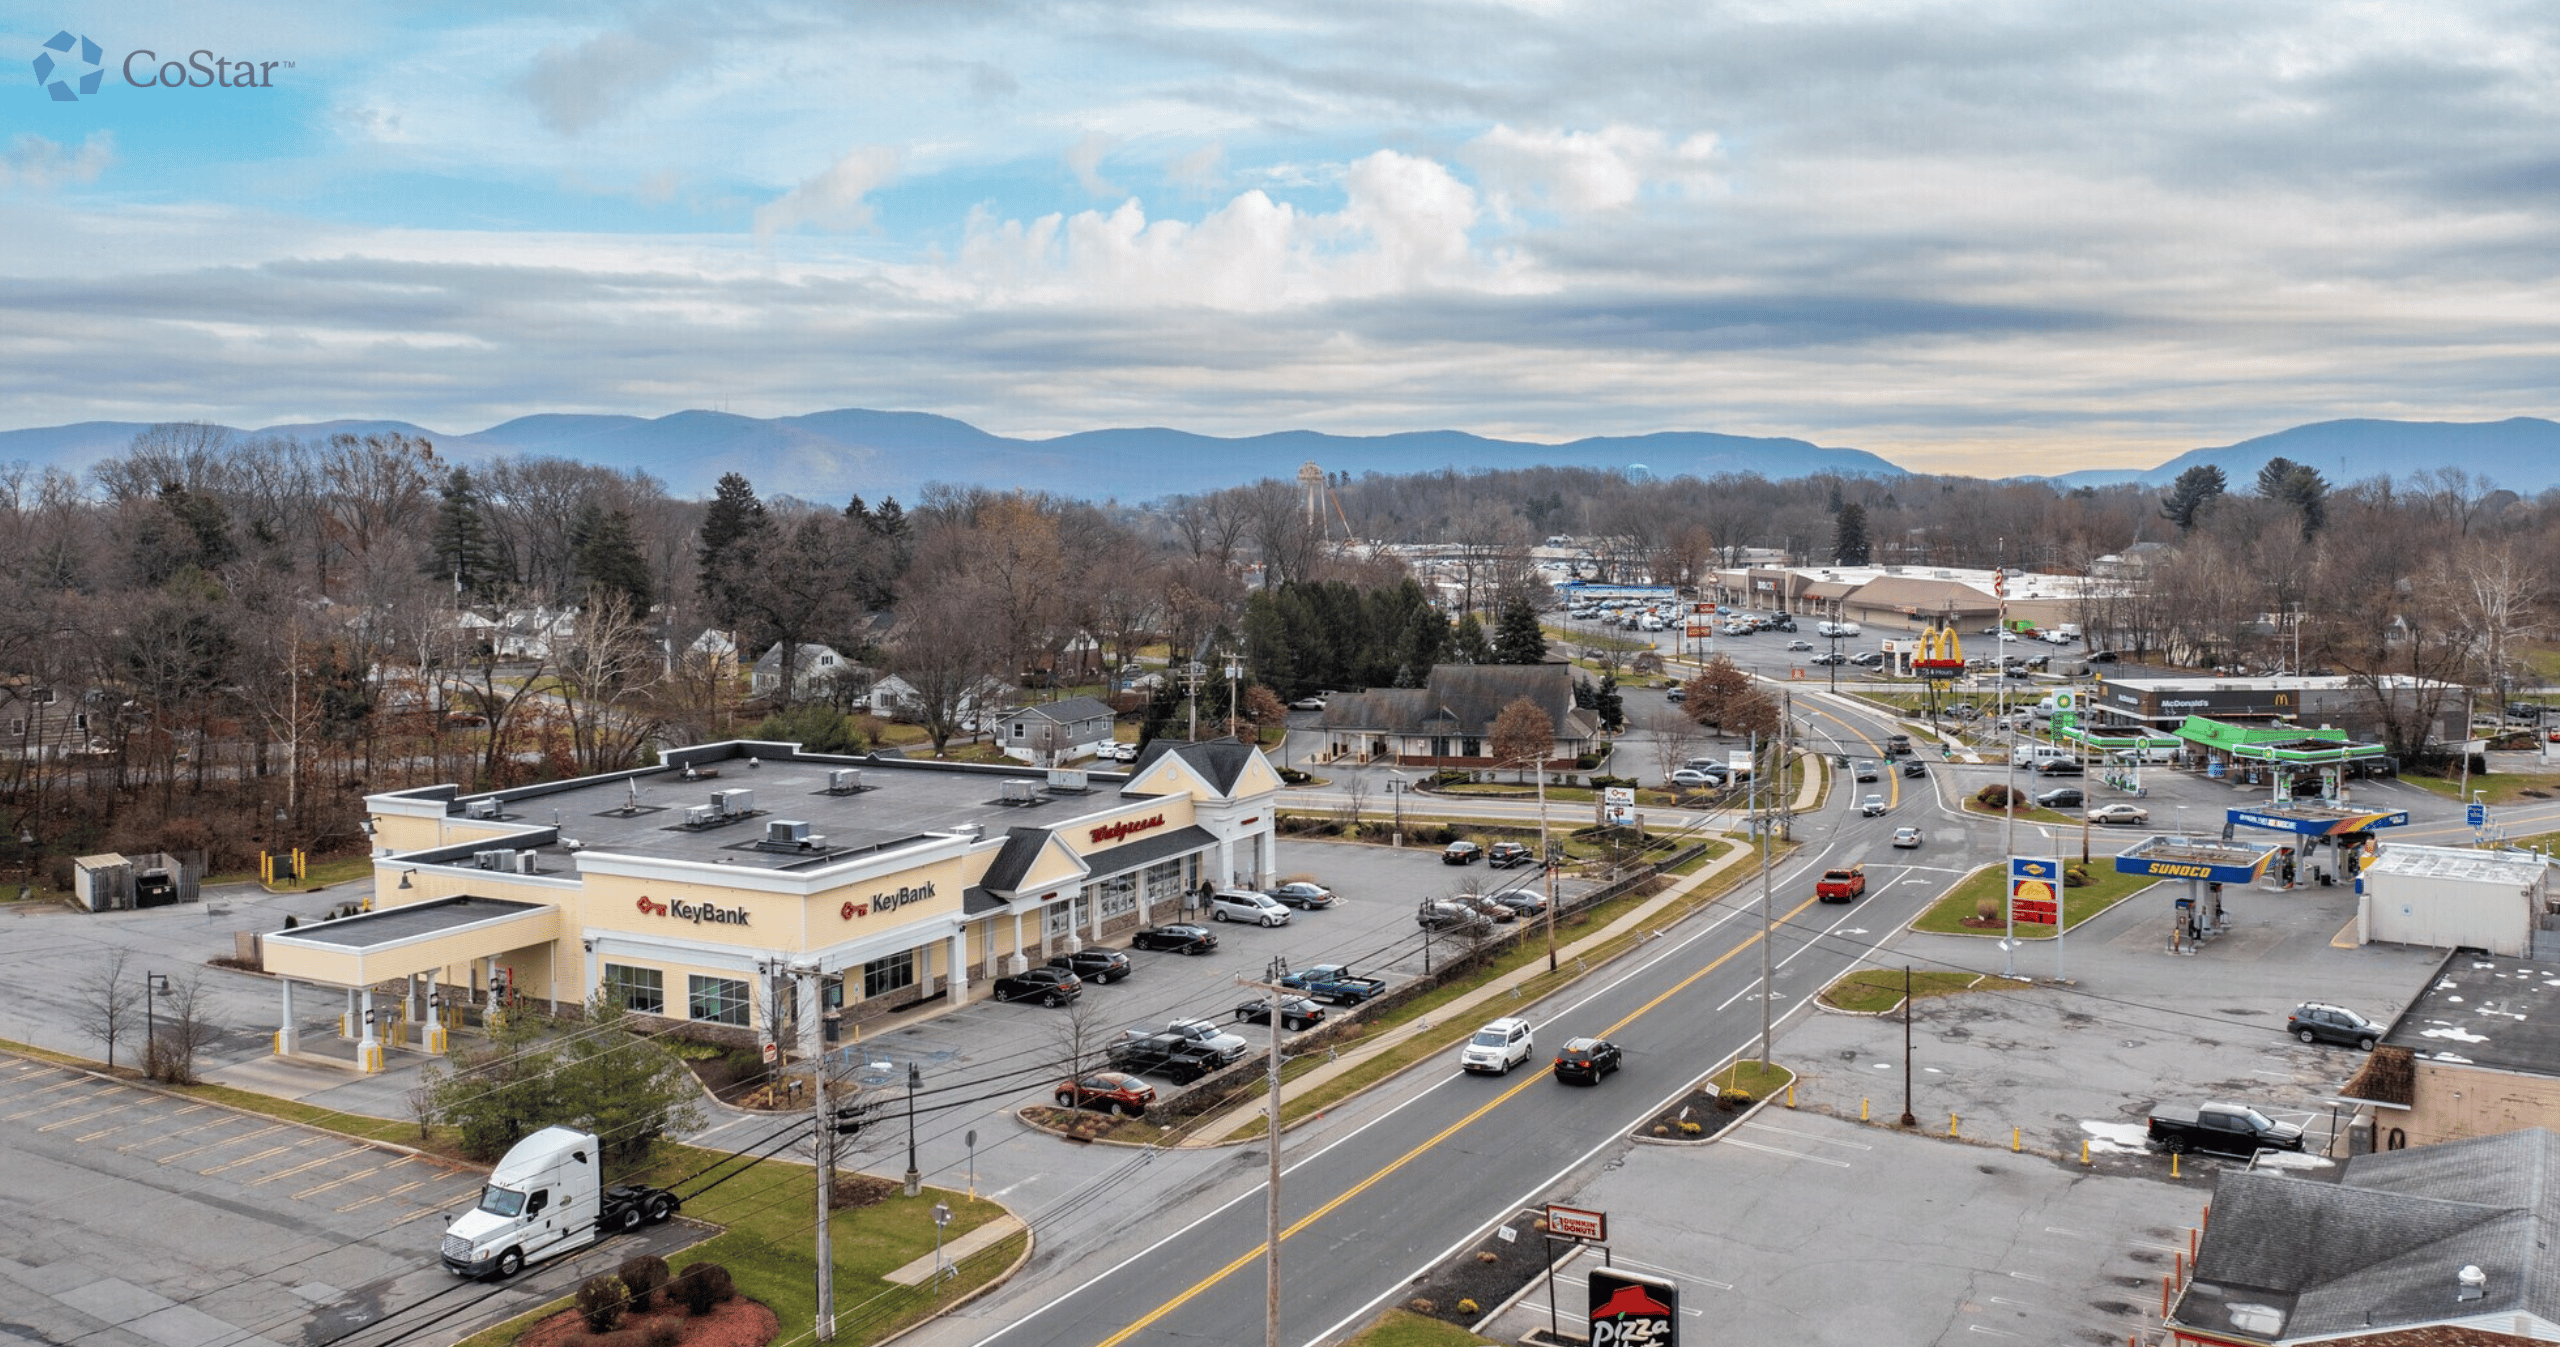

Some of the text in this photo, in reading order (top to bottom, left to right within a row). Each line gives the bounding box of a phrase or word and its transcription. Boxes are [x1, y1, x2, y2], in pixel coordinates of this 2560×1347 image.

[1089, 813, 1166, 844] Walgreens
[2148, 862, 2212, 878] SUNOCO
[871, 881, 936, 913] KeyBank
[670, 898, 751, 926] KeyBank
[1563, 1225, 1597, 1236] DONUTS
[1592, 1312, 1671, 1347] Pizza
